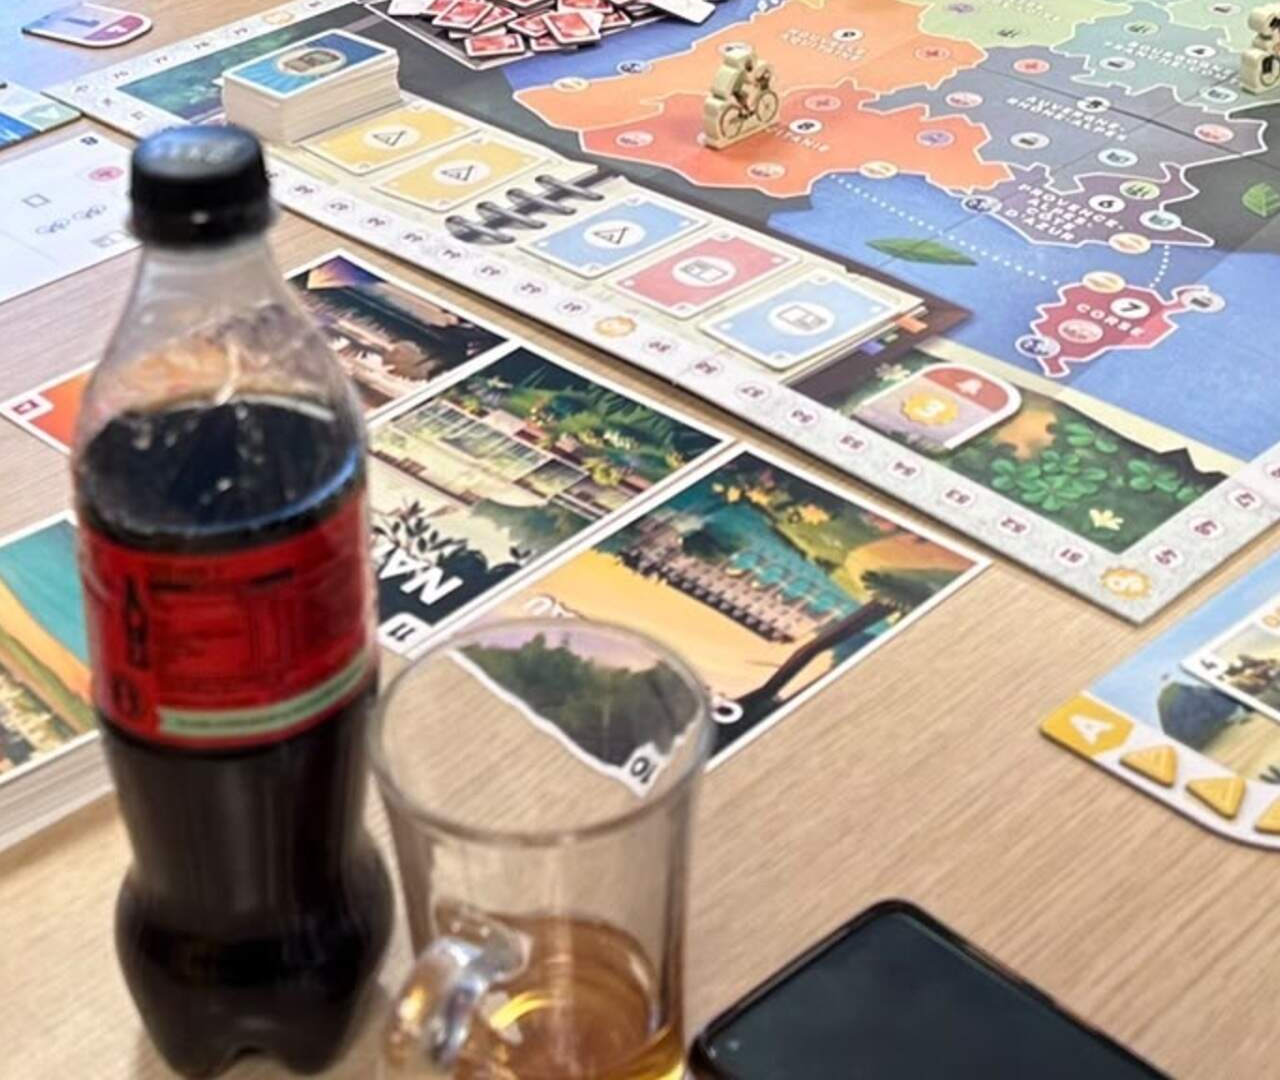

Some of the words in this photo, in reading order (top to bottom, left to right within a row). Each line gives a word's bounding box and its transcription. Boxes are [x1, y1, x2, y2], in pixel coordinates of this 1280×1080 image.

[1119, 301, 1142, 313] 7
[894, 461, 916, 477] 54
[945, 489, 970, 505] 53
[1000, 517, 1026, 534] 52
[1060, 548, 1083, 563] 51
[387, 622, 417, 642] 11
